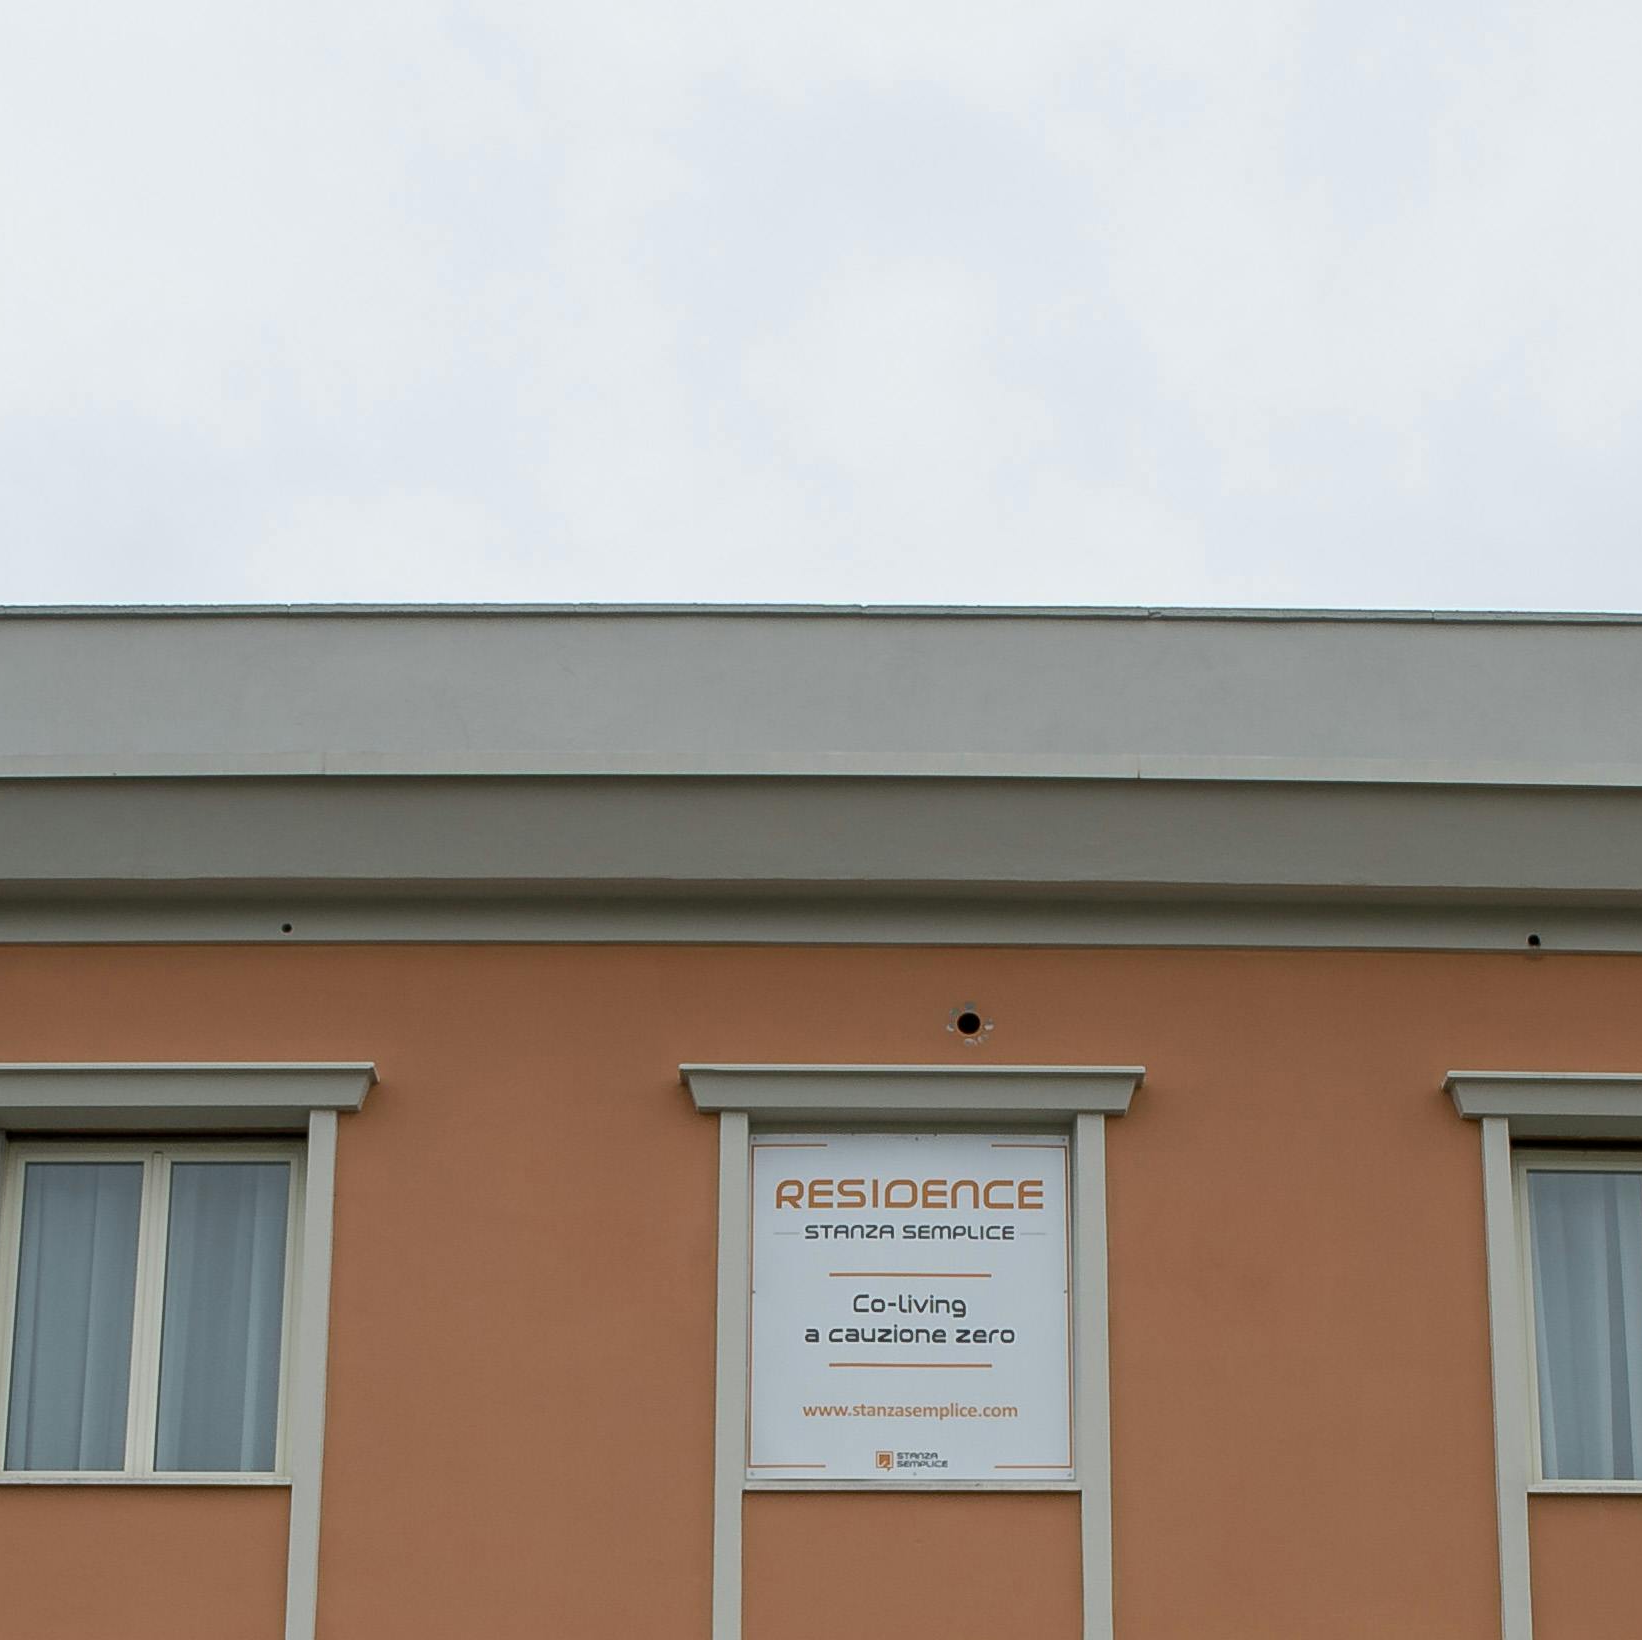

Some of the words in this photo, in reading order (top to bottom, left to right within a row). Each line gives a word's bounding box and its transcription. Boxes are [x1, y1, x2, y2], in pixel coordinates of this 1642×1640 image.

[774, 1179, 1045, 1209] RESIDENCE
[805, 1225, 894, 1240] STANZA
[902, 1225, 1014, 1240] SEMPLICE
[853, 1294, 966, 1318] Co-living
[805, 1329, 819, 1343] a
[829, 1324, 946, 1344] cauzione
[956, 1329, 1015, 1344] zero
[803, 1403, 1018, 1420] www.stanzasemplice.com
[896, 1452, 939, 1460] STANZA
[896, 1460, 949, 1468] SEMPLICE
